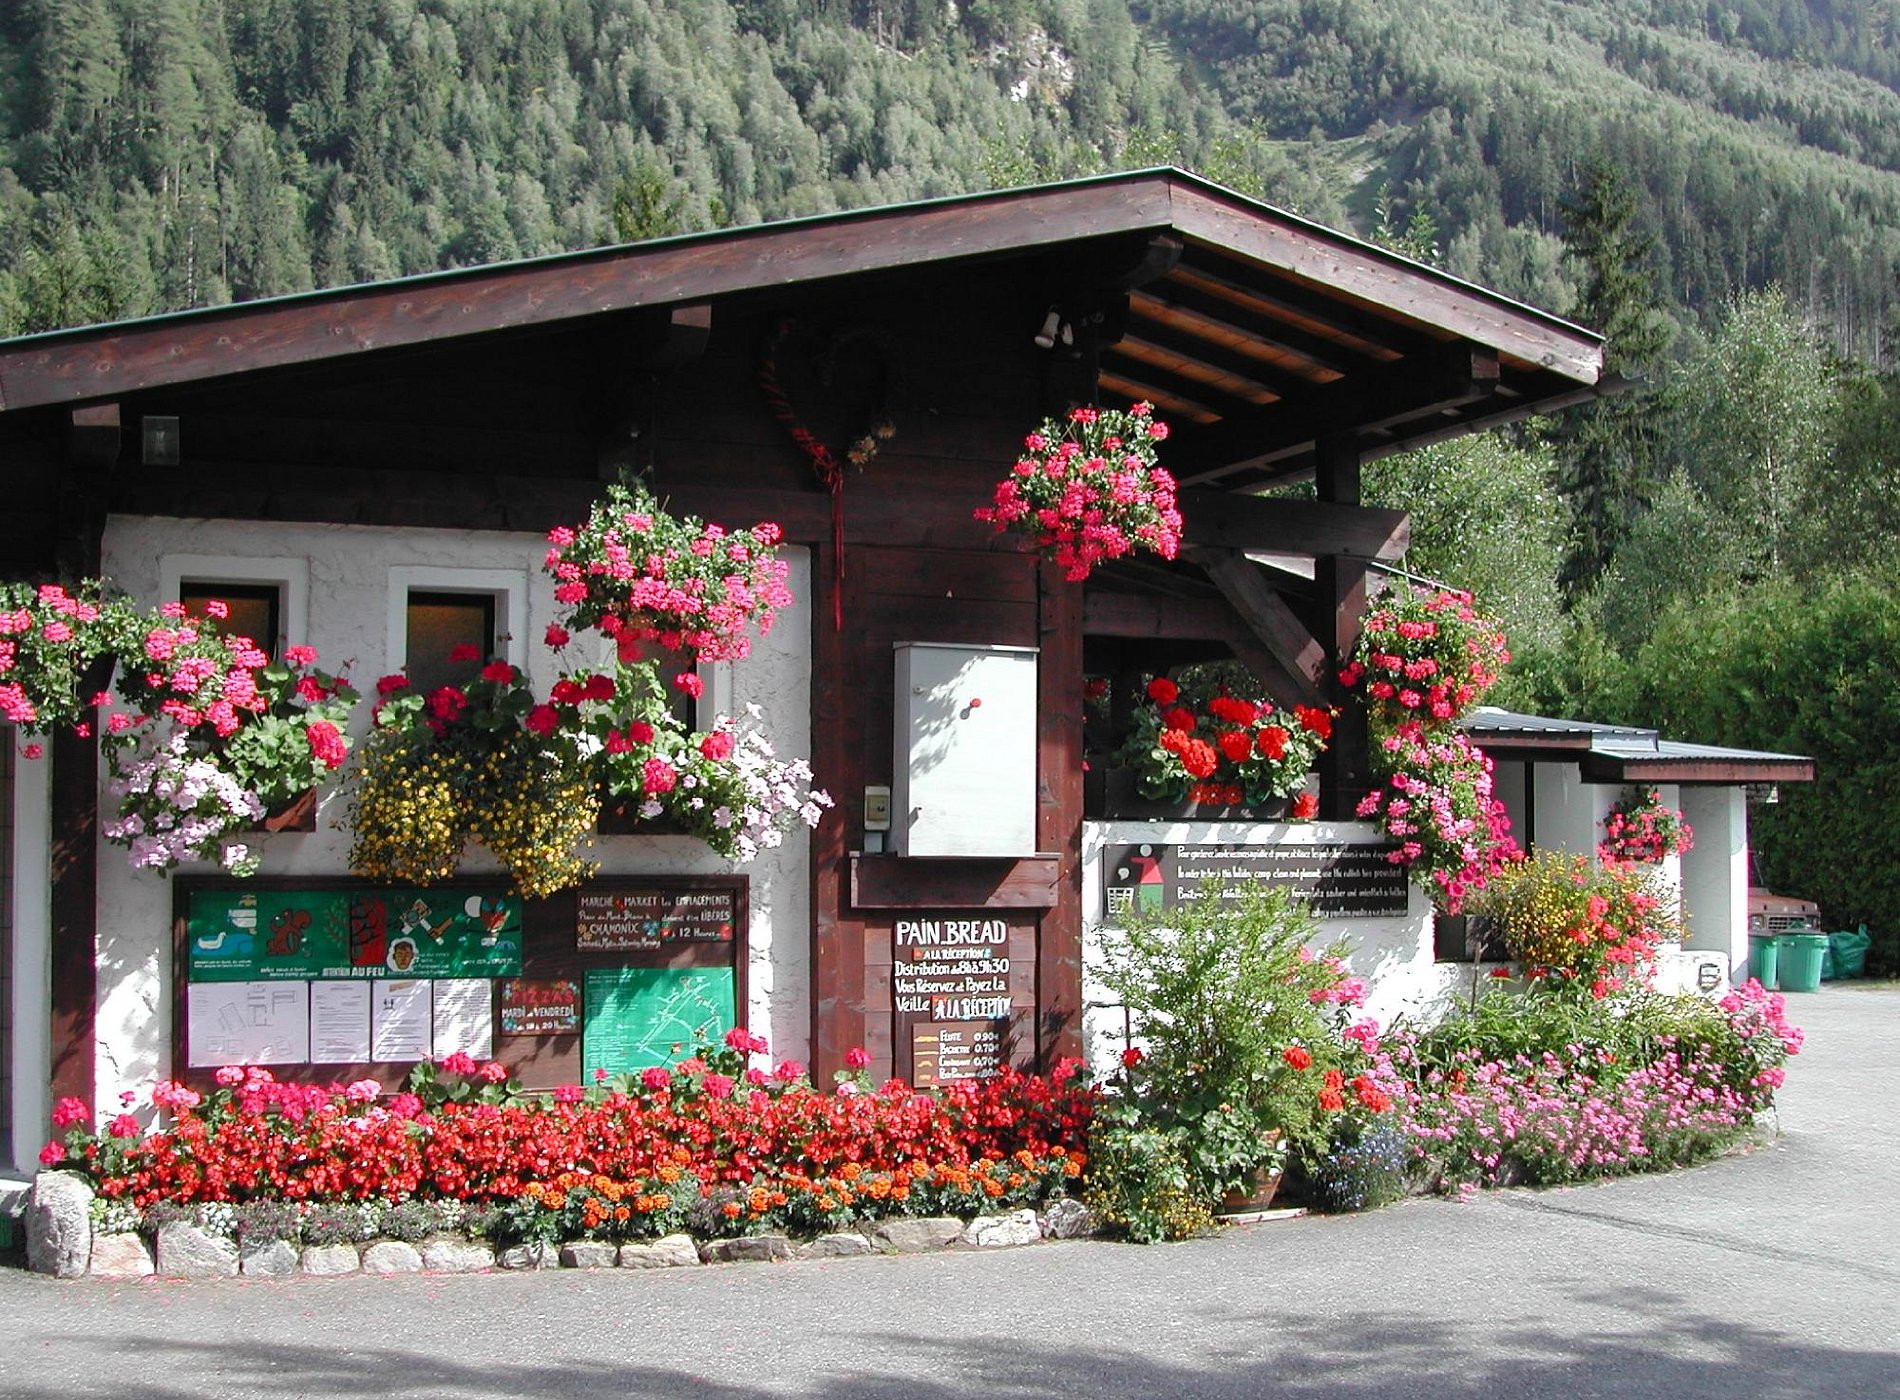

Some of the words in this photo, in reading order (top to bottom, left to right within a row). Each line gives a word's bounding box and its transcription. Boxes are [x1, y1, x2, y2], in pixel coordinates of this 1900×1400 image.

[1254, 870, 1271, 880] camp
[1272, 867, 1289, 878] clean
[581, 895, 613, 908] MARCHÉ
[624, 896, 657, 907] MARKET
[675, 895, 730, 906] EMPLACEMENTS
[589, 921, 639, 935] CHAMONIX
[679, 927, 691, 938] 12
[896, 919, 940, 945] PAIN
[941, 920, 1006, 945] BREAD
[351, 966, 366, 976] AU
[366, 966, 386, 977] FEU
[894, 961, 950, 976] Distribution
[979, 958, 1010, 974] 9h30
[894, 978, 915, 993] Vous
[915, 978, 955, 993] Réservez
[965, 977, 992, 994] Payez
[512, 988, 574, 1004] PIZZAS
[501, 1005, 526, 1018] MARDI
[533, 1004, 574, 1017] VENDREDI
[895, 996, 931, 1012] Veille
[541, 1021, 553, 1030] 20
